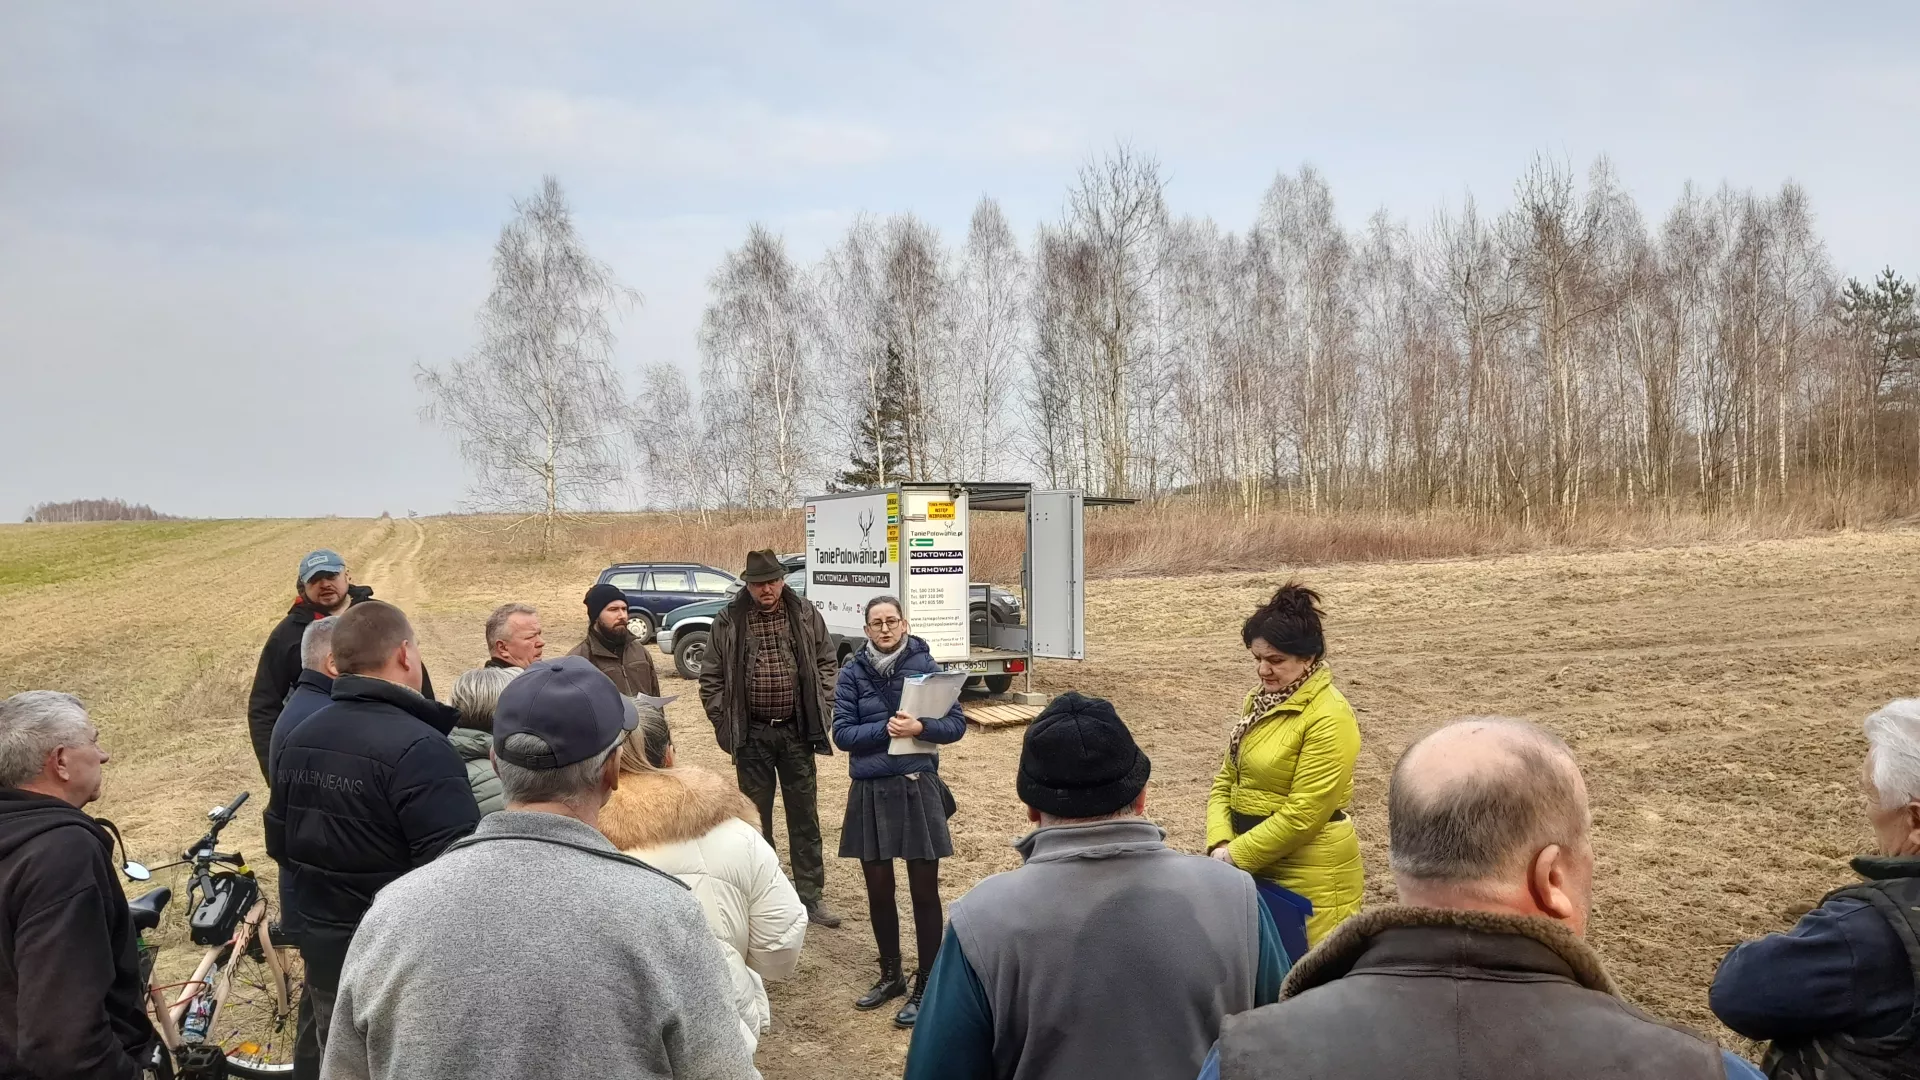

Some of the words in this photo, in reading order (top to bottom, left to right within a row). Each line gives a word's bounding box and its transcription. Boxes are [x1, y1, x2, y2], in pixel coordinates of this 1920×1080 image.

[815, 548, 887, 568] TaniePolowanie.pl
[815, 573, 849, 583] NOKTOWIZJA
[851, 574, 889, 584] TERMOWIZJA
[949, 662, 962, 671] SKL
